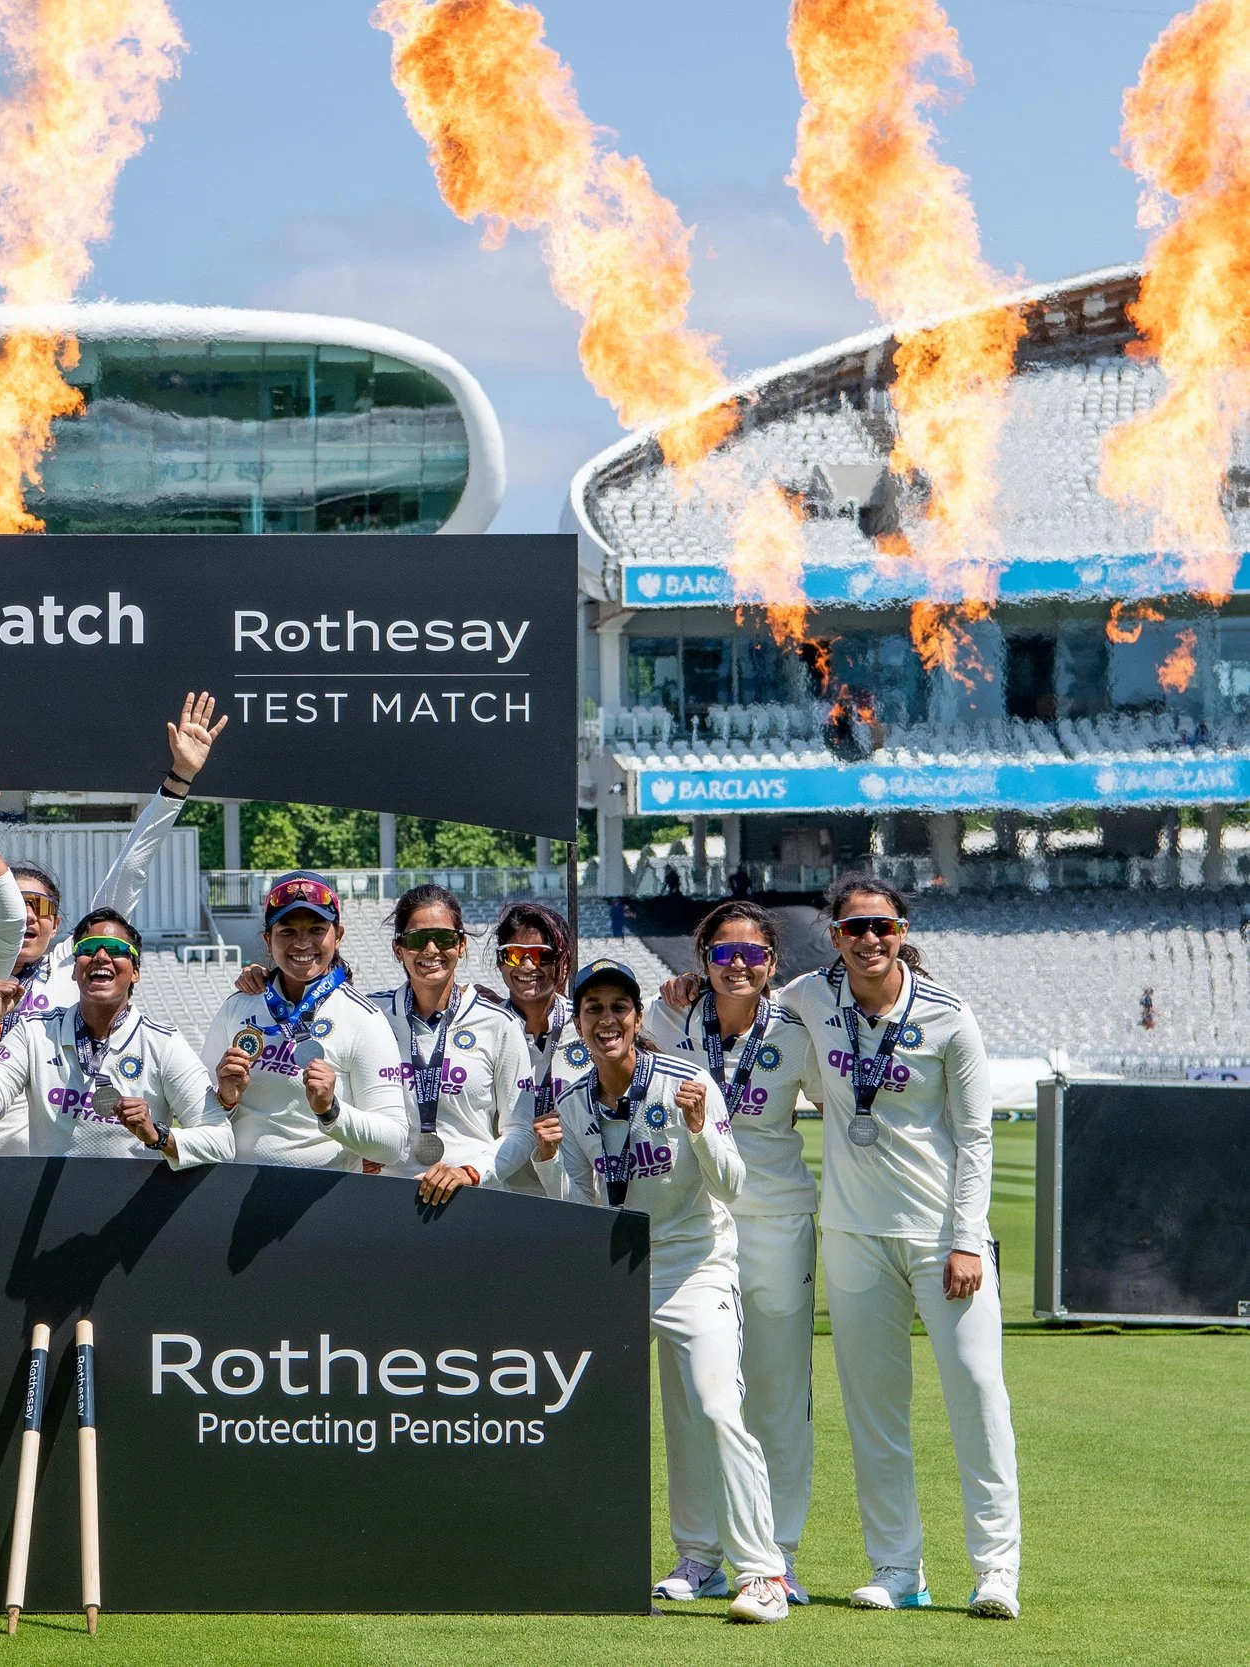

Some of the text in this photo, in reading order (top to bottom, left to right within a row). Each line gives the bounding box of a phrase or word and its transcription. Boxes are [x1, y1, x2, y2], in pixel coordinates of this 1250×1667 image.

[665, 573, 720, 596] BARC
[235, 609, 531, 664] Rothesay
[235, 692, 531, 723] TEST MATCH
[679, 778, 788, 801] BARCLAYS
[311, 979, 333, 998] BCCI
[250, 1059, 301, 1077] TYRES
[708, 1034, 716, 1069] Rothesay
[739, 1050, 749, 1069] MATCH
[746, 1038, 762, 1071] Rothesay
[431, 1067, 441, 1102] Rothesay
[639, 1054, 649, 1087] Rothesay
[866, 1053, 882, 1086] TEST MATCH
[872, 1054, 890, 1088] Rothesay
[415, 1069, 424, 1104] Rothesay
[629, 1162, 672, 1181] YRES
[24, 1359, 40, 1420] Rothesay
[76, 1355, 85, 1417] Rothesay
[151, 1333, 593, 1413] Rothesay
[198, 1412, 545, 1453] Protecting Pensions
